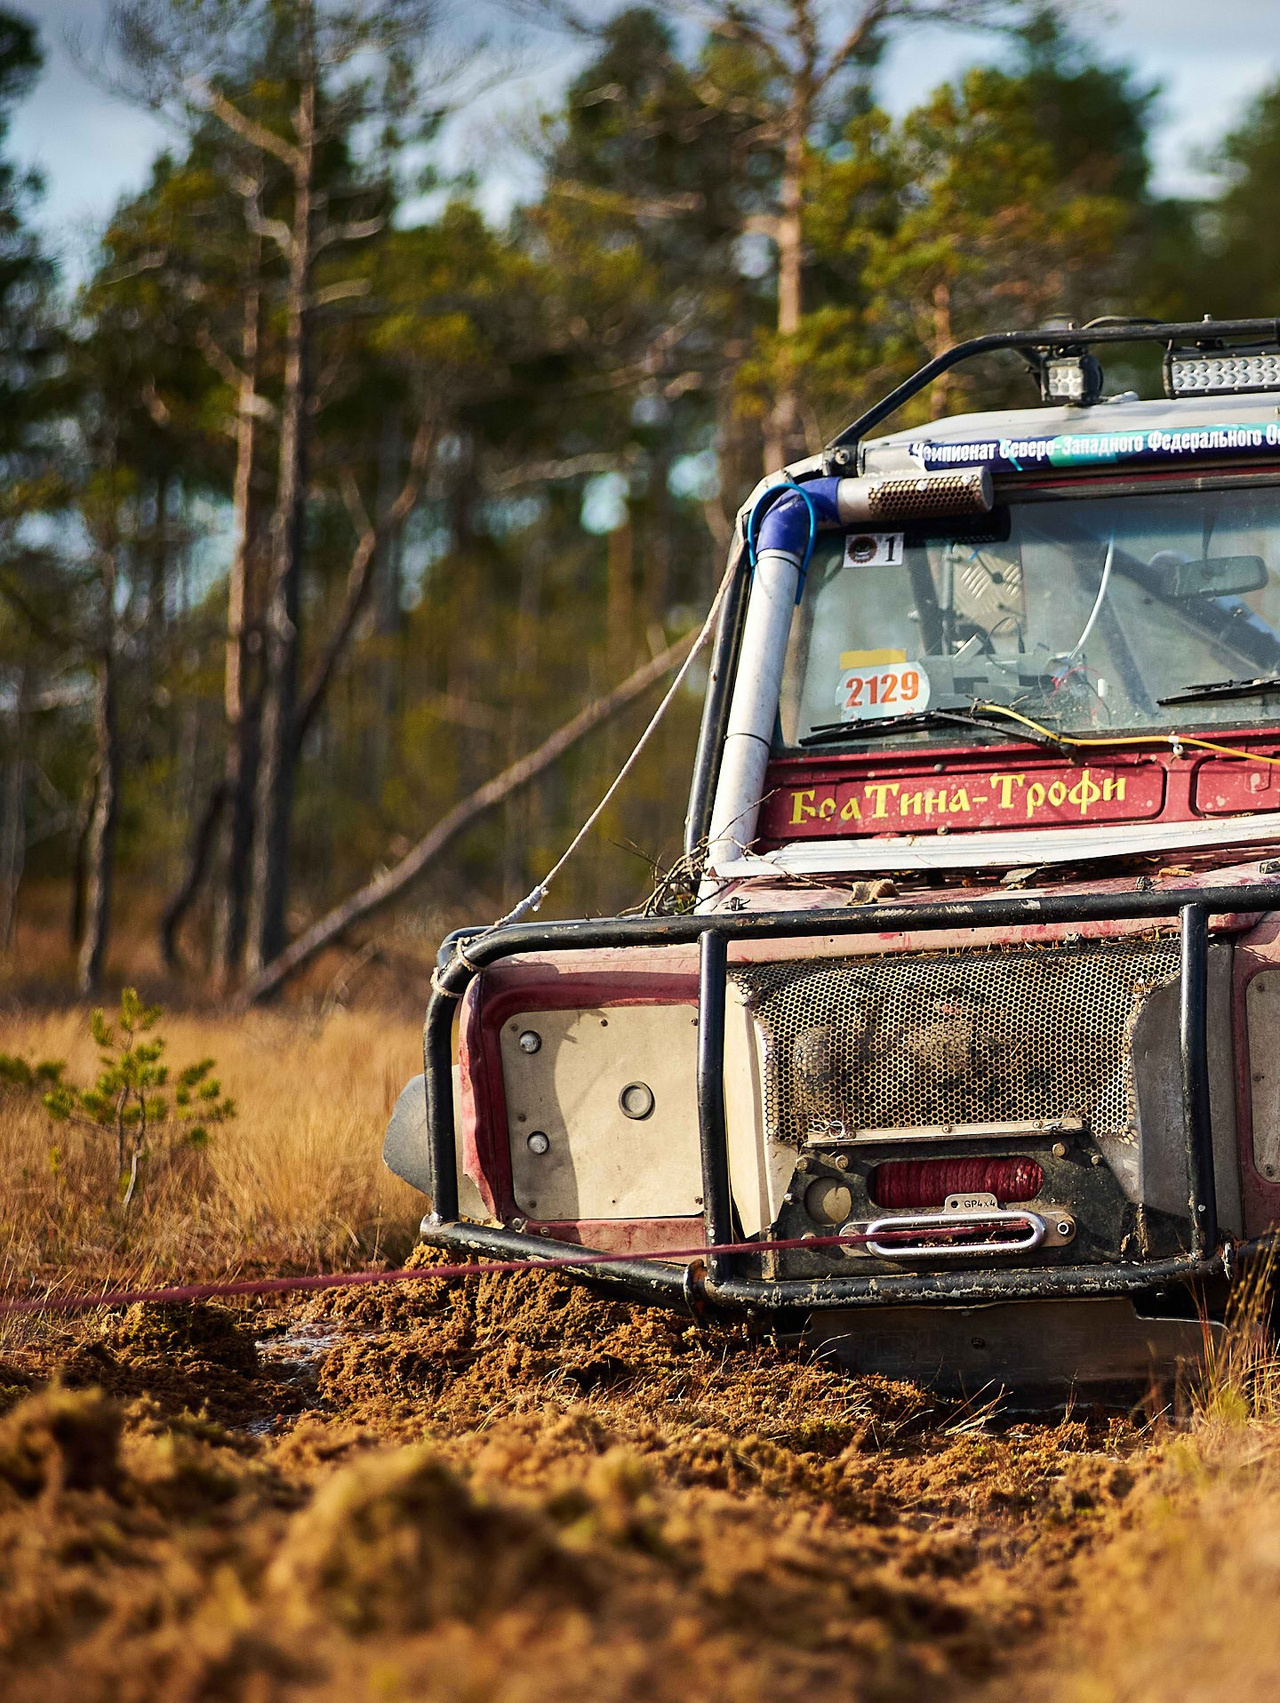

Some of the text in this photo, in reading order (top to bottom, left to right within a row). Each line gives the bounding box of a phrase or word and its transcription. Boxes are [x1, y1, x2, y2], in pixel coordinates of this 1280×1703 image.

[912, 443, 997, 463] Чемпионат
[1000, 433, 1143, 461] Северо-Западного
[1148, 430, 1262, 453] Федерального
[885, 535, 895, 562] 1
[845, 671, 920, 708] 2129
